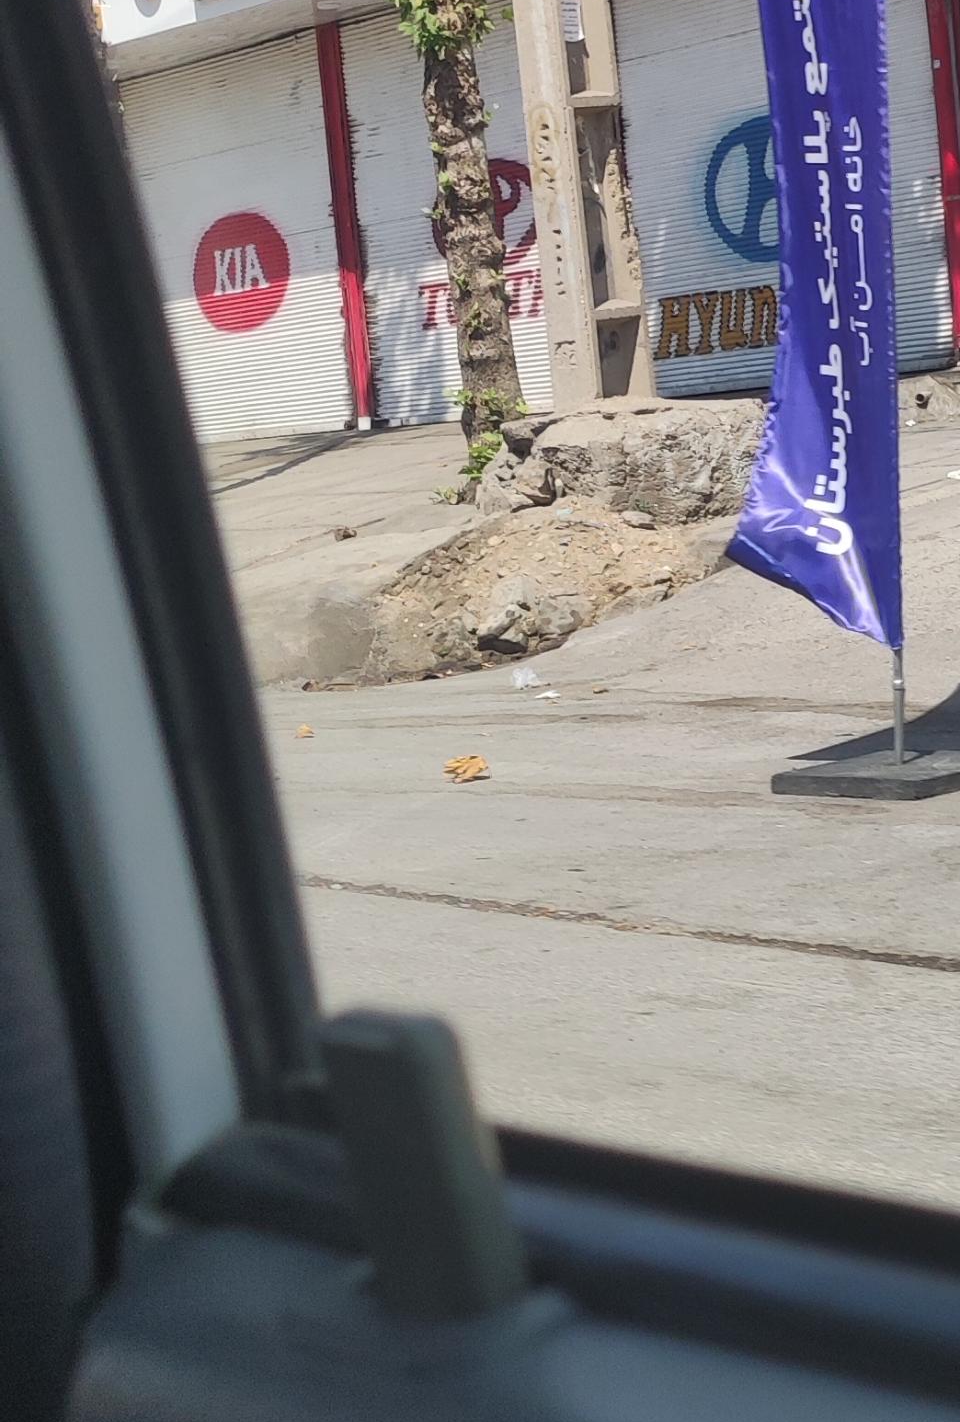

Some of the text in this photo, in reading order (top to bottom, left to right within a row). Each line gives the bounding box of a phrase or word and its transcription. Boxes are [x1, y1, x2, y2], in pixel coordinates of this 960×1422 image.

[842, 115, 864, 193] خانه
[803, 109, 840, 330] پلاستیک
[213, 242, 271, 297] KIA
[850, 315, 874, 367] آب
[803, 342, 854, 557] طبرستان
